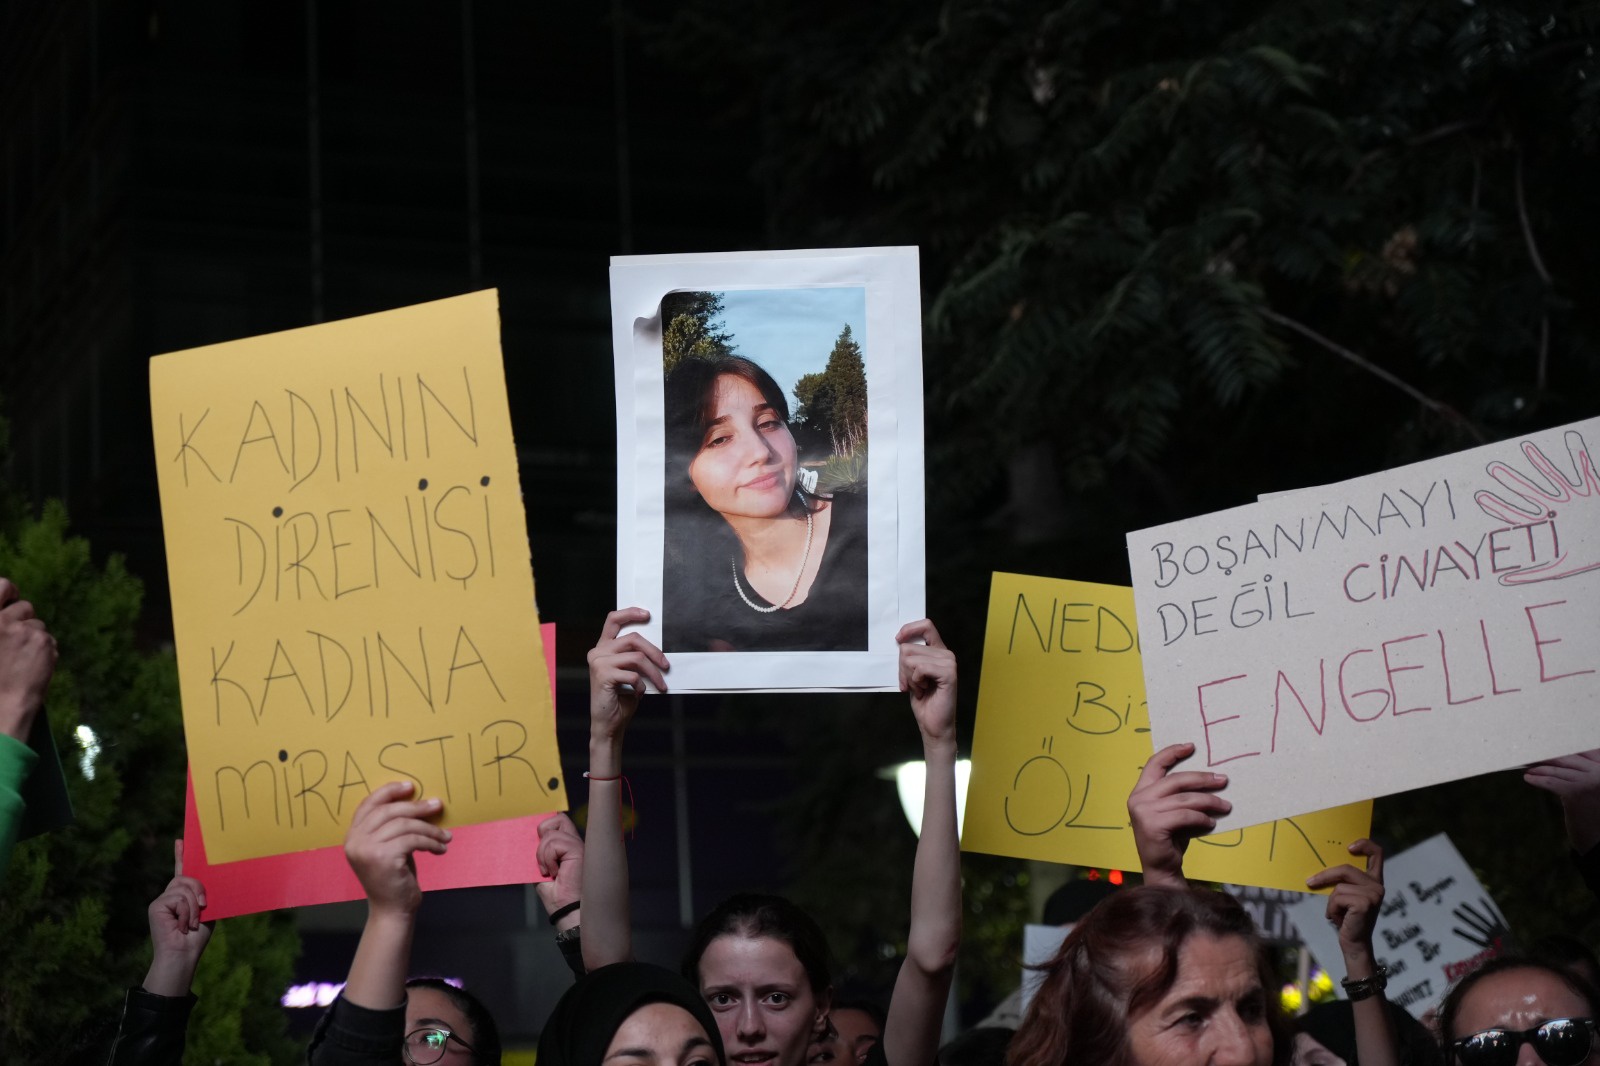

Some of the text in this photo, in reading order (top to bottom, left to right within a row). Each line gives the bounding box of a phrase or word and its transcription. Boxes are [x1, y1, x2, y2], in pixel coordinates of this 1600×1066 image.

[174, 366, 478, 493] KADININ
[224, 475, 495, 616] DİRENİŞİ
[1151, 479, 1456, 588] BOŞANMAYI
[1156, 511, 1559, 647] DEĞİL CİNAYETİ
[211, 625, 506, 727] KADINA
[1009, 592, 1141, 654] NED
